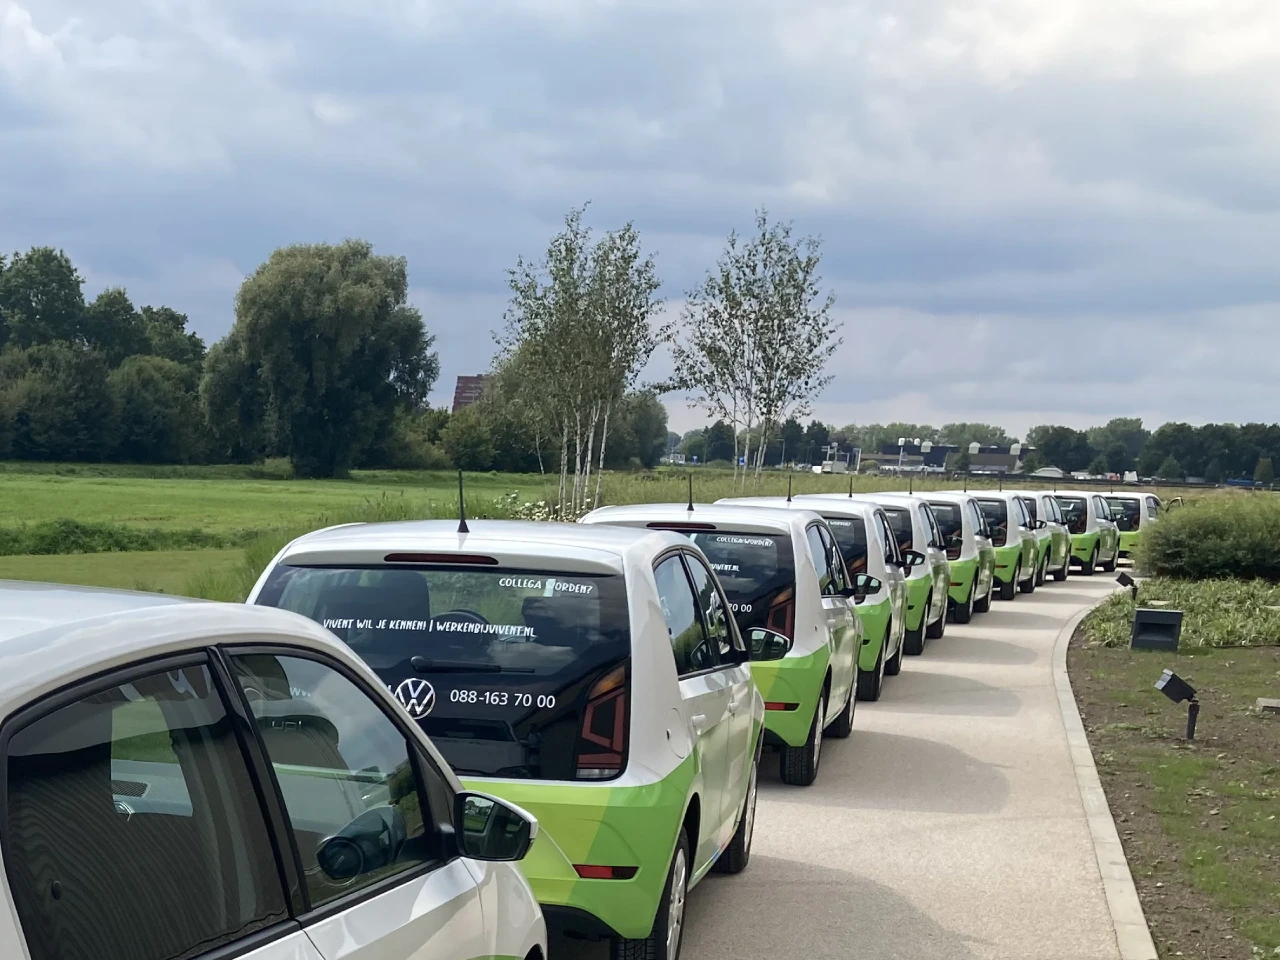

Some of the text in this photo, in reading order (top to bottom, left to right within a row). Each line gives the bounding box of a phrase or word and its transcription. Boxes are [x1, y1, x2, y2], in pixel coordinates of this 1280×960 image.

[499, 578, 542, 589] COLLEGA
[323, 618, 355, 630] VIVENT
[356, 619, 374, 630] WIL
[376, 619, 388, 630] JE
[389, 619, 427, 631] KENNEN!
[436, 621, 536, 637] WERKENBIJVIVENT.NL
[450, 689, 556, 709] 088-163 70 00
